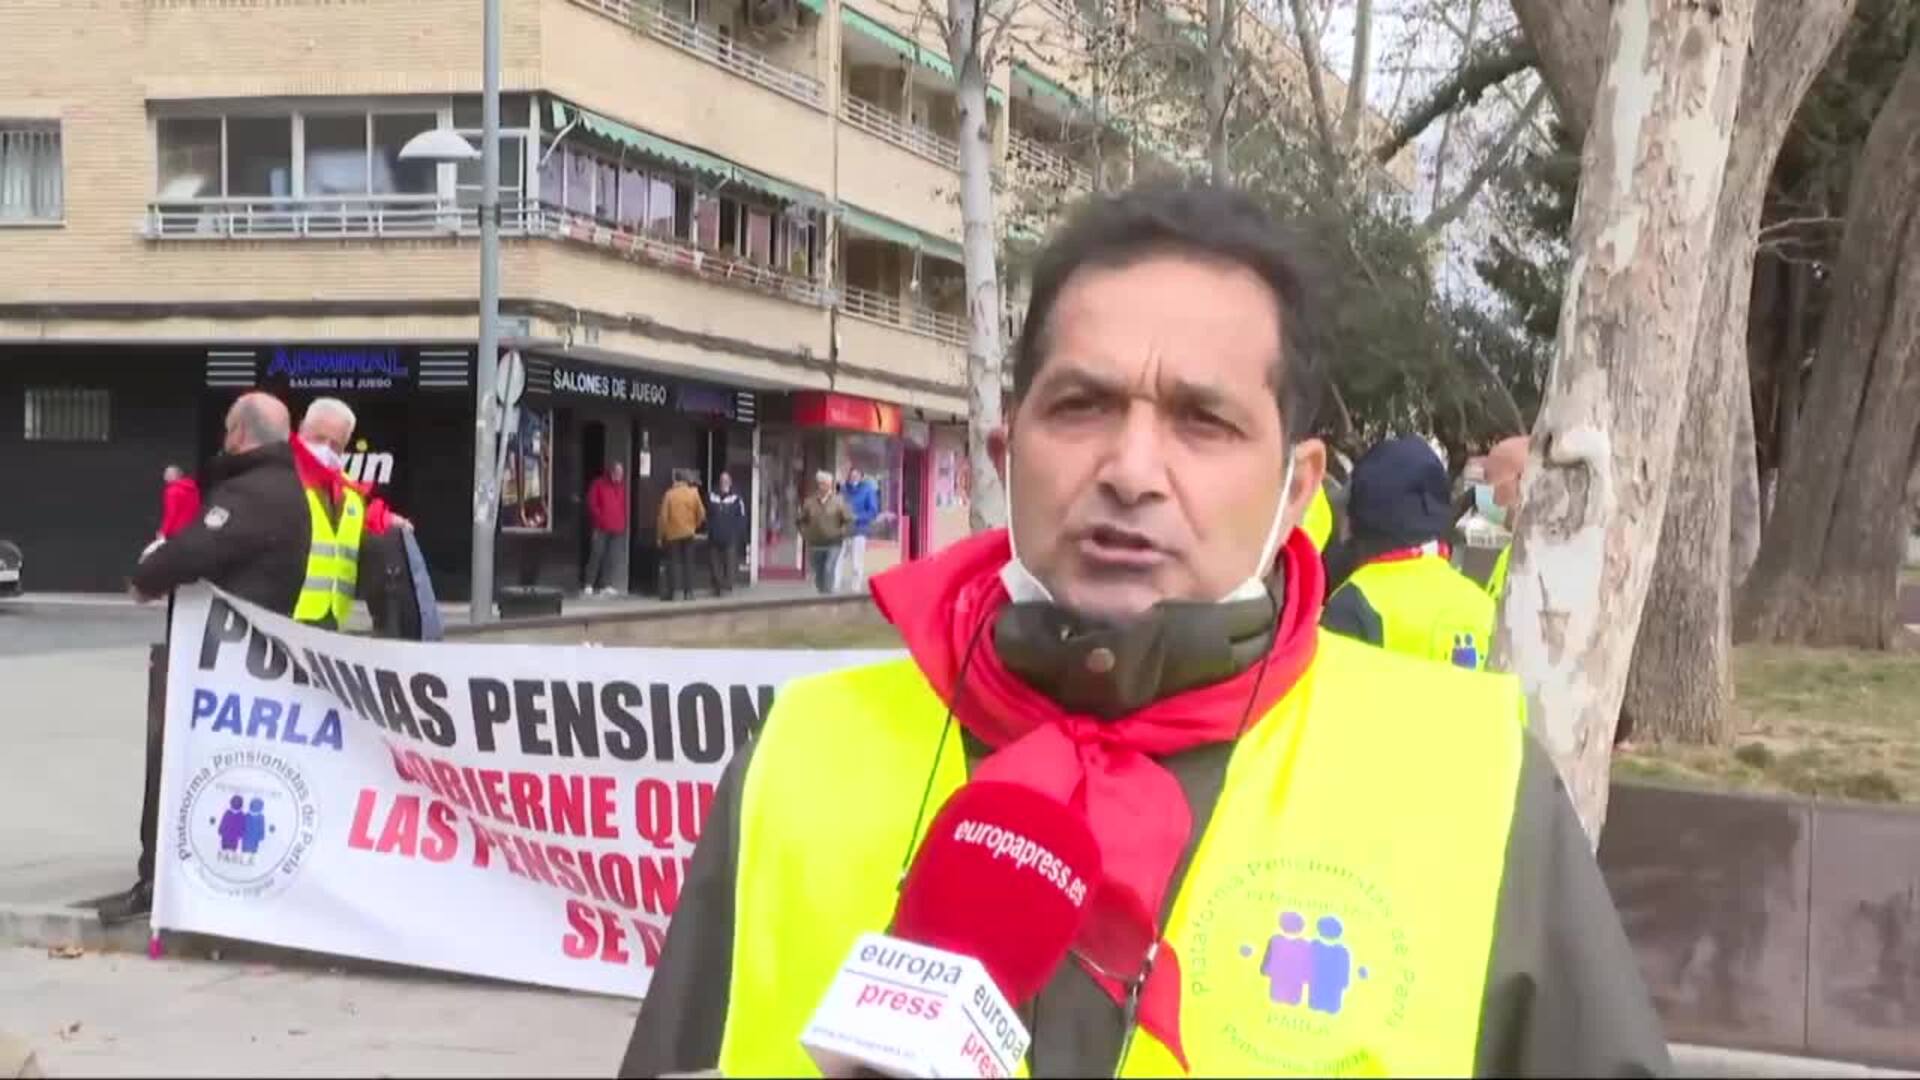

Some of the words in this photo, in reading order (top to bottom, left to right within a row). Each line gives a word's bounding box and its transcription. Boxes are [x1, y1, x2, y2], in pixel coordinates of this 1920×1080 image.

[553, 368, 610, 396] SALONES
[611, 378, 627, 399] DE
[629, 383, 667, 406] JUEGO
[338, 438, 394, 484] in
[191, 688, 343, 750] PARLA
[468, 677, 775, 765] PENSION
[212, 751, 309, 802] Pensionistas
[347, 788, 458, 863] LAS
[467, 816, 692, 916] PENSION
[954, 820, 1087, 907] europapress.es
[563, 899, 629, 964] SE
[859, 943, 963, 985] europa
[856, 982, 943, 1021] press
[973, 984, 1025, 1062] europa
